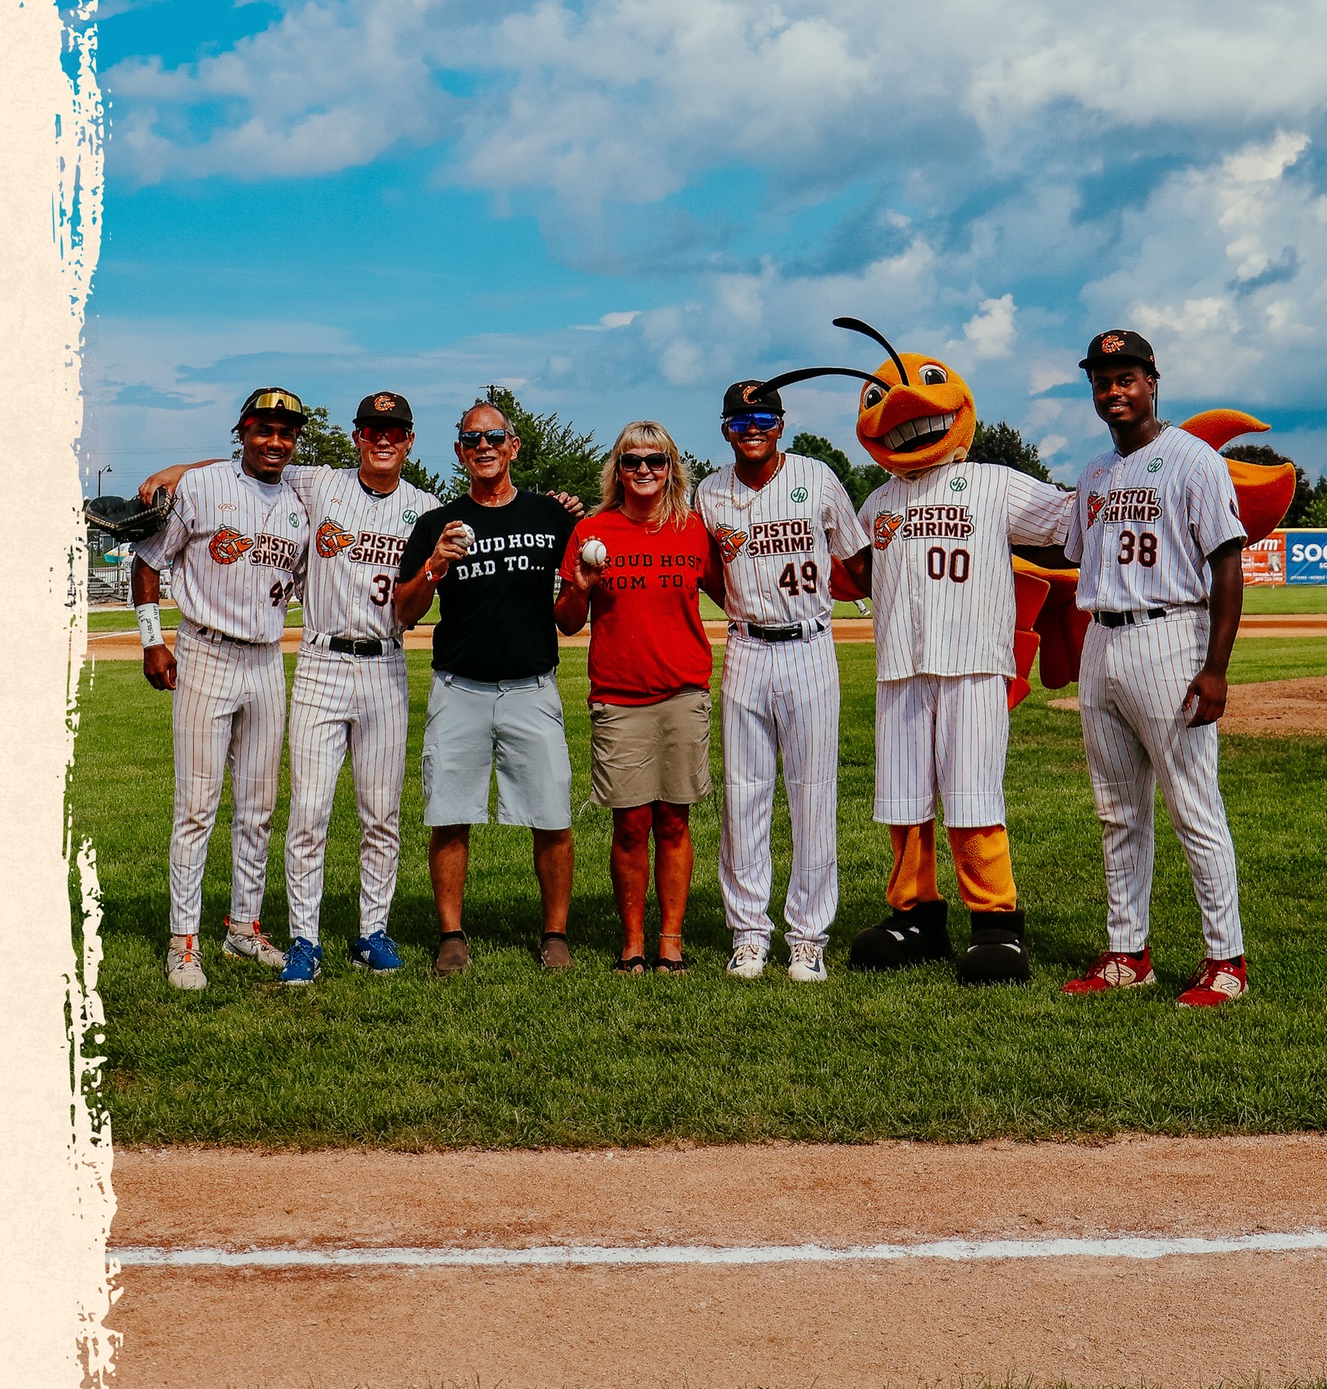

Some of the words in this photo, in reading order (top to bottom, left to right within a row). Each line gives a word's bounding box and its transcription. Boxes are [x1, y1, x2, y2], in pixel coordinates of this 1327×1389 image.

[1109, 489, 1157, 507] PISTOL
[906, 506, 970, 523] PISTOL
[1104, 505, 1160, 522] SHRIMP
[752, 519, 812, 540] PISTOL
[902, 521, 973, 539] SHRIMP
[359, 532, 407, 552] PISTO
[466, 536, 506, 556] OUD
[507, 533, 556, 549] HOST
[747, 536, 814, 557] SHRIMP
[1117, 530, 1159, 568] 38
[1242, 538, 1280, 551] arm
[350, 547, 402, 568] SHRIM
[604, 554, 654, 569] ROUD
[660, 554, 703, 571] HOST
[1291, 543, 1327, 563] SO
[456, 559, 496, 580] DAD
[504, 555, 545, 572] TO...
[927, 545, 971, 584] 00
[601, 575, 647, 591] MOM
[778, 560, 818, 597] 49
[370, 573, 397, 609] 3
